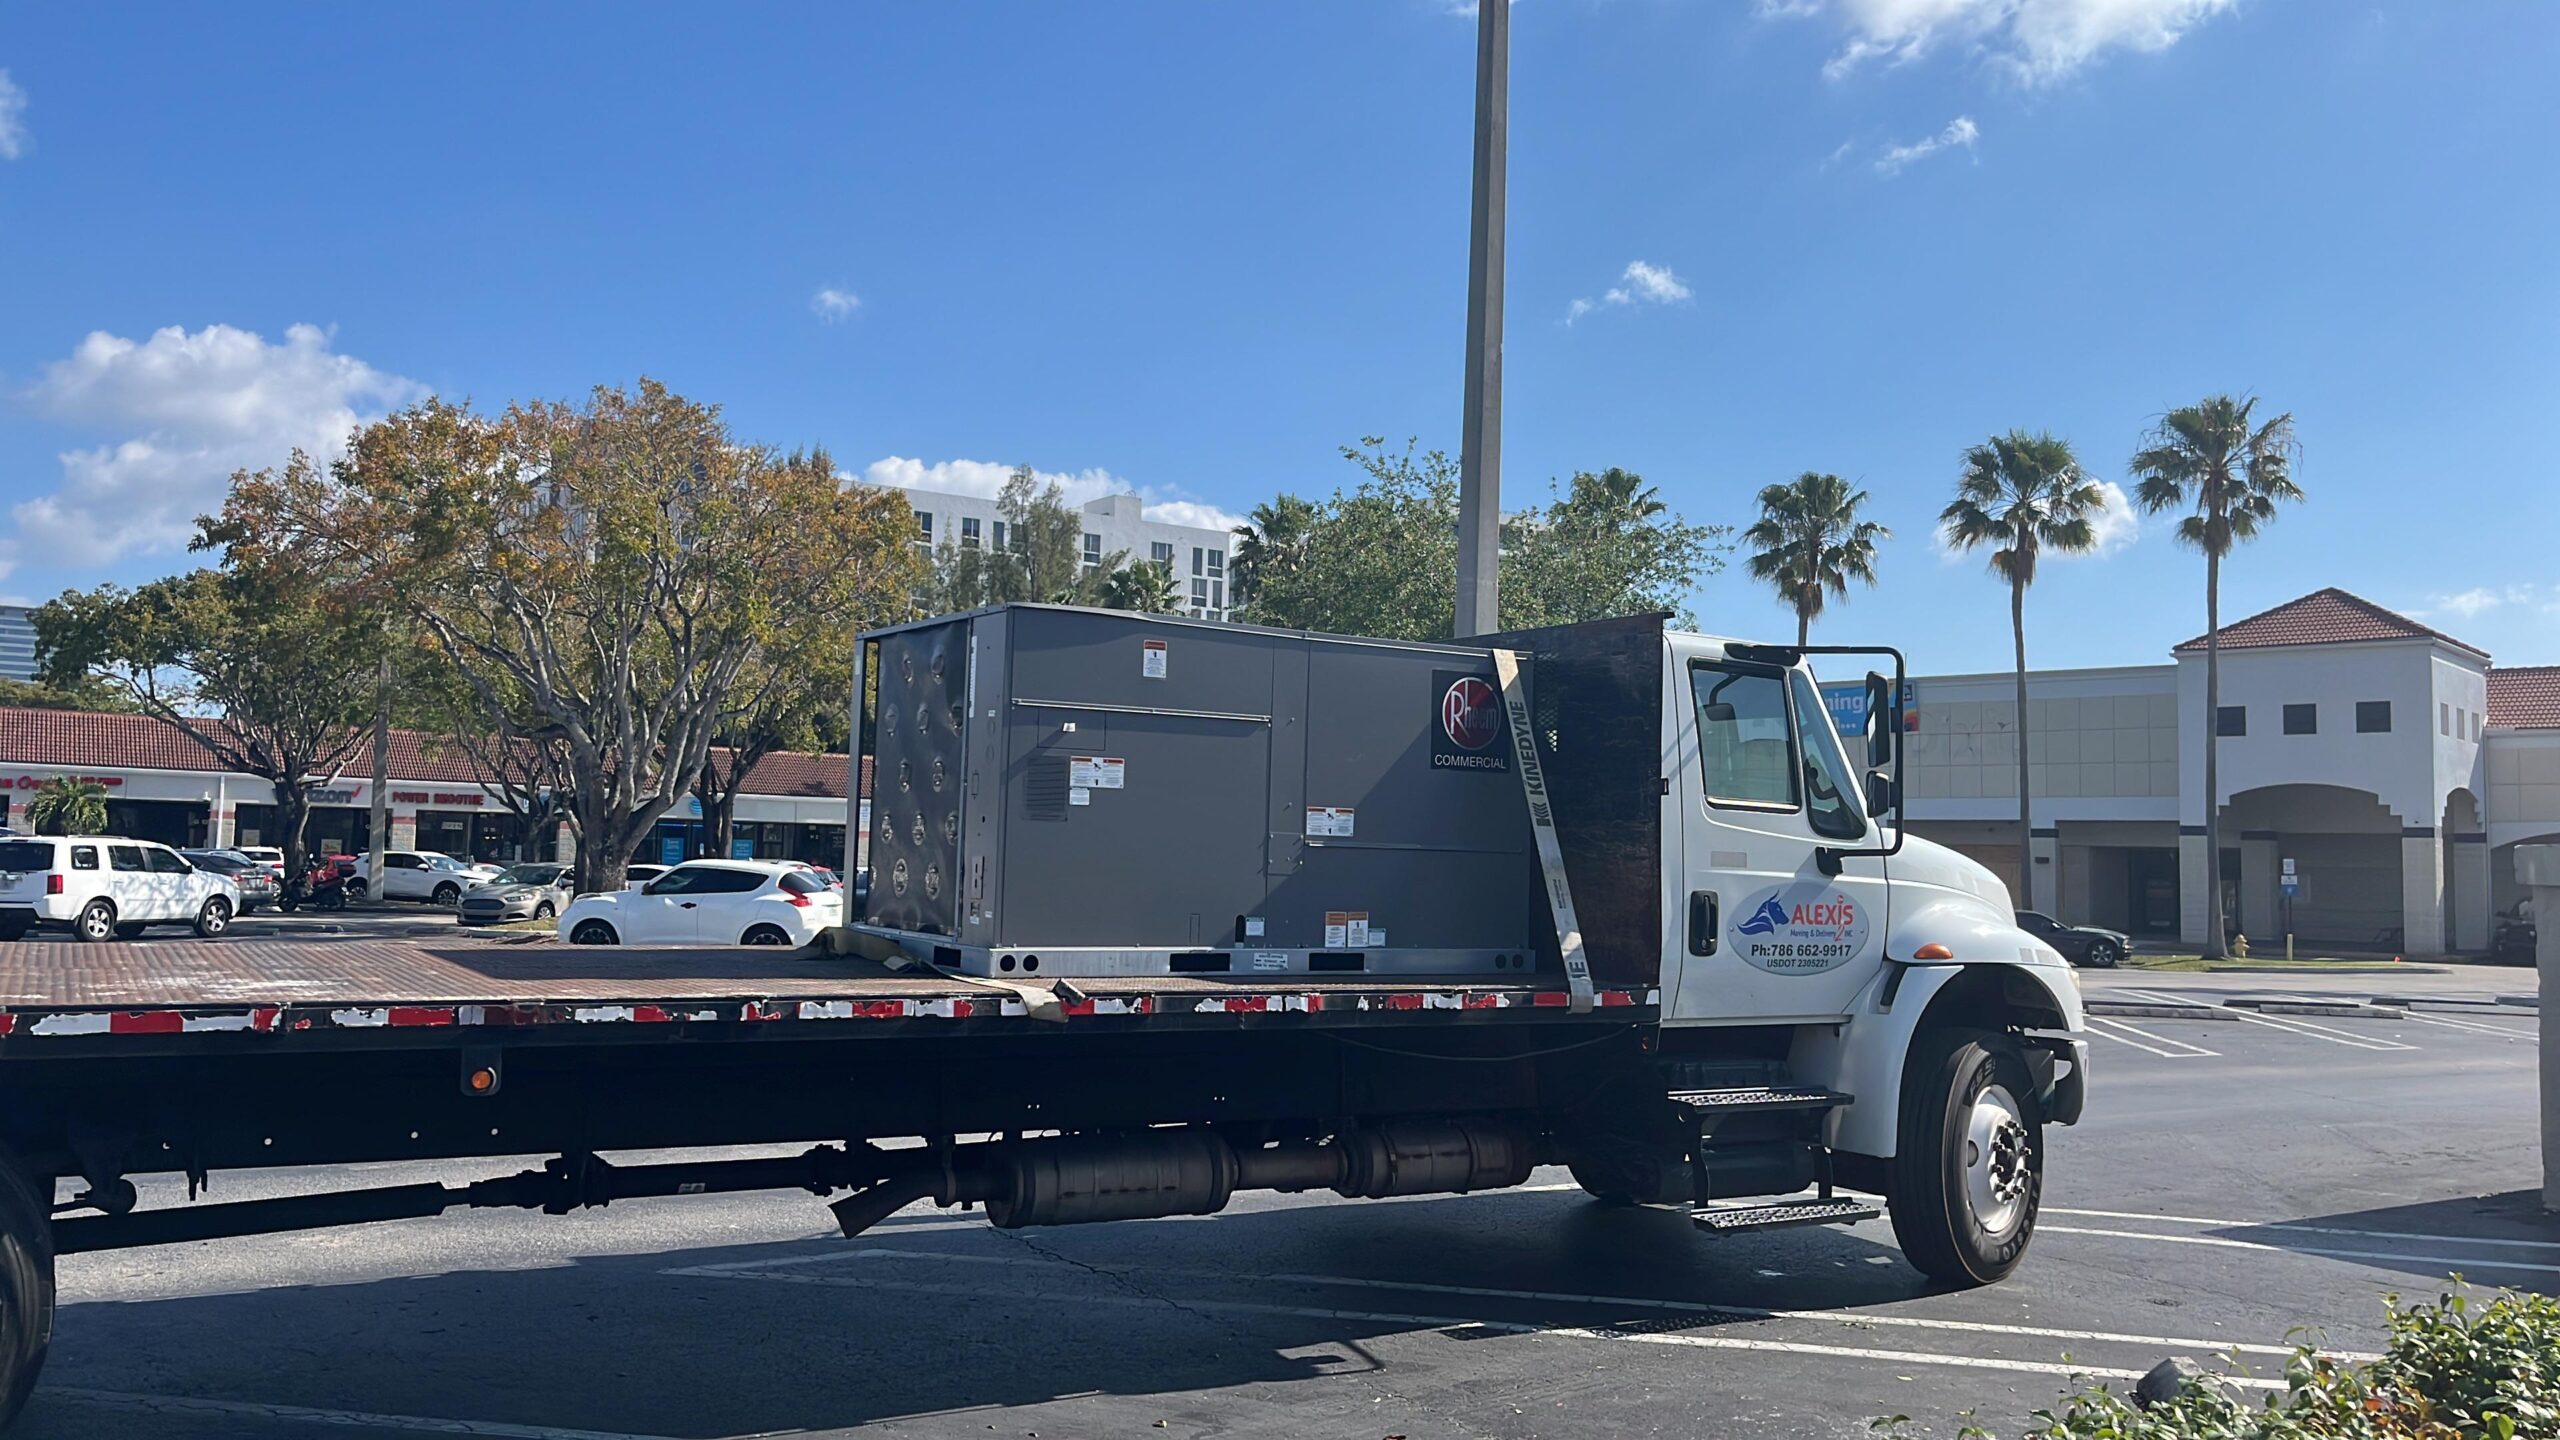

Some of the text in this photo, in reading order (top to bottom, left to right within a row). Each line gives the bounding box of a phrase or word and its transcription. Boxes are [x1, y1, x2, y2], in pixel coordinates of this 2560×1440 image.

[1450, 680, 1498, 738] Rheem
[1509, 700, 1545, 796] KINEDYNE
[1434, 754, 1507, 769] COMMERCIAL
[1751, 944, 1852, 957] Ph:786 662-9917
[1767, 959, 1828, 968] USDOT 2305221
